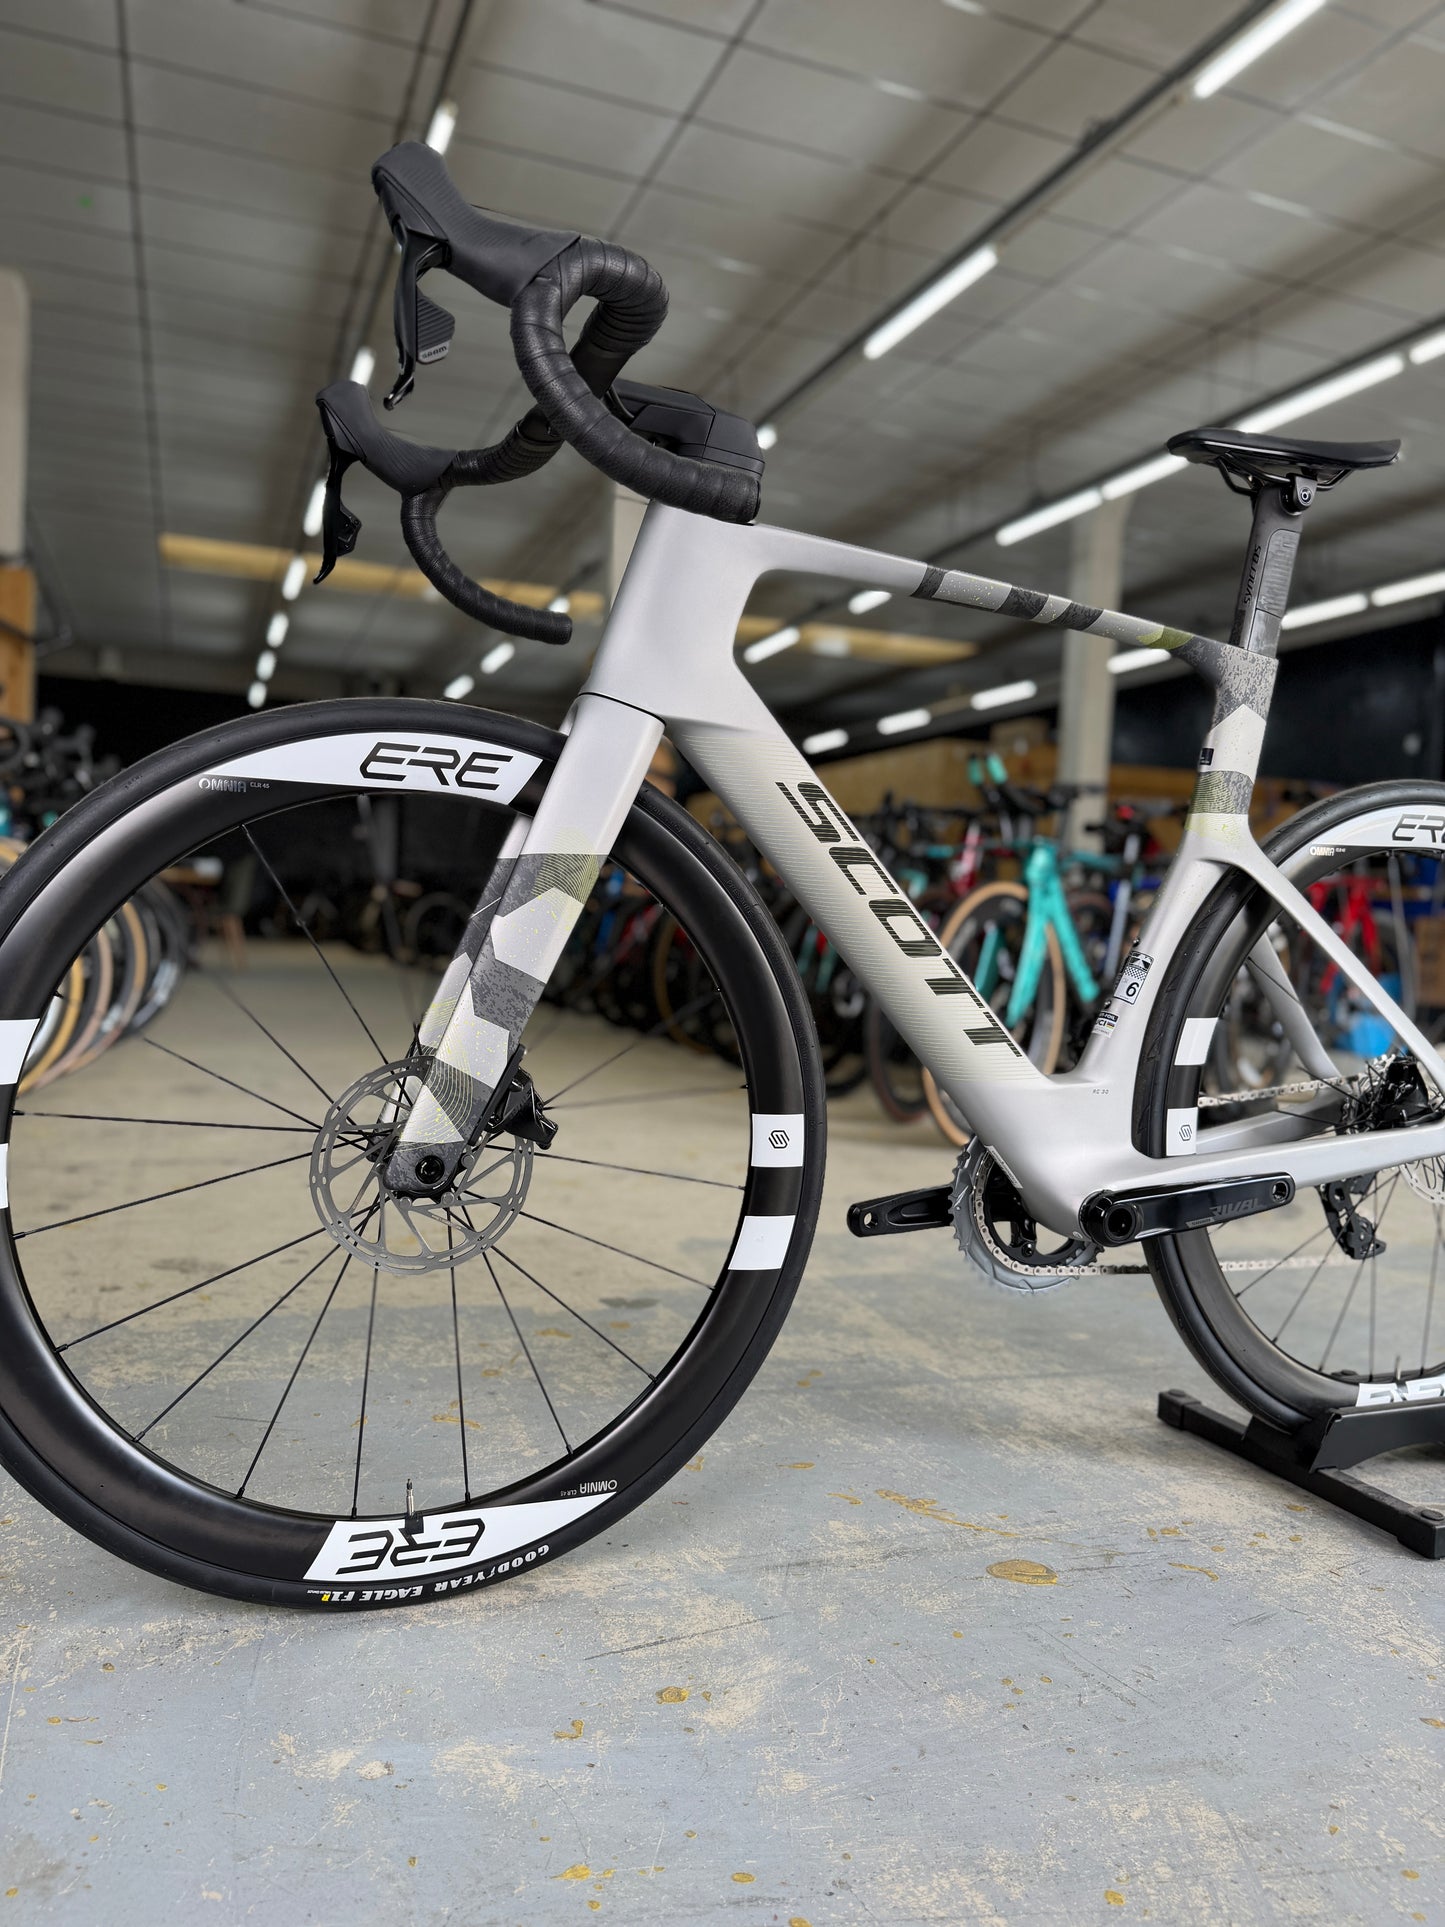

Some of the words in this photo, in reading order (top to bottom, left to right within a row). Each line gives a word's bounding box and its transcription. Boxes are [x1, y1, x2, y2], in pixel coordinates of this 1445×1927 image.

[359, 741, 514, 791] ERE
[198, 778, 247, 792] OMNIA
[1392, 813, 1445, 843] ER
[775, 781, 1022, 1057] SCOTT
[1125, 981, 1140, 998] 6
[1209, 1198, 1266, 1217] RIVAL
[579, 1480, 618, 1494] OMNIA
[335, 1517, 486, 1576] ERE
[434, 1544, 550, 1593] GOODYEAR
[358, 1585, 424, 1602] EAGLE
